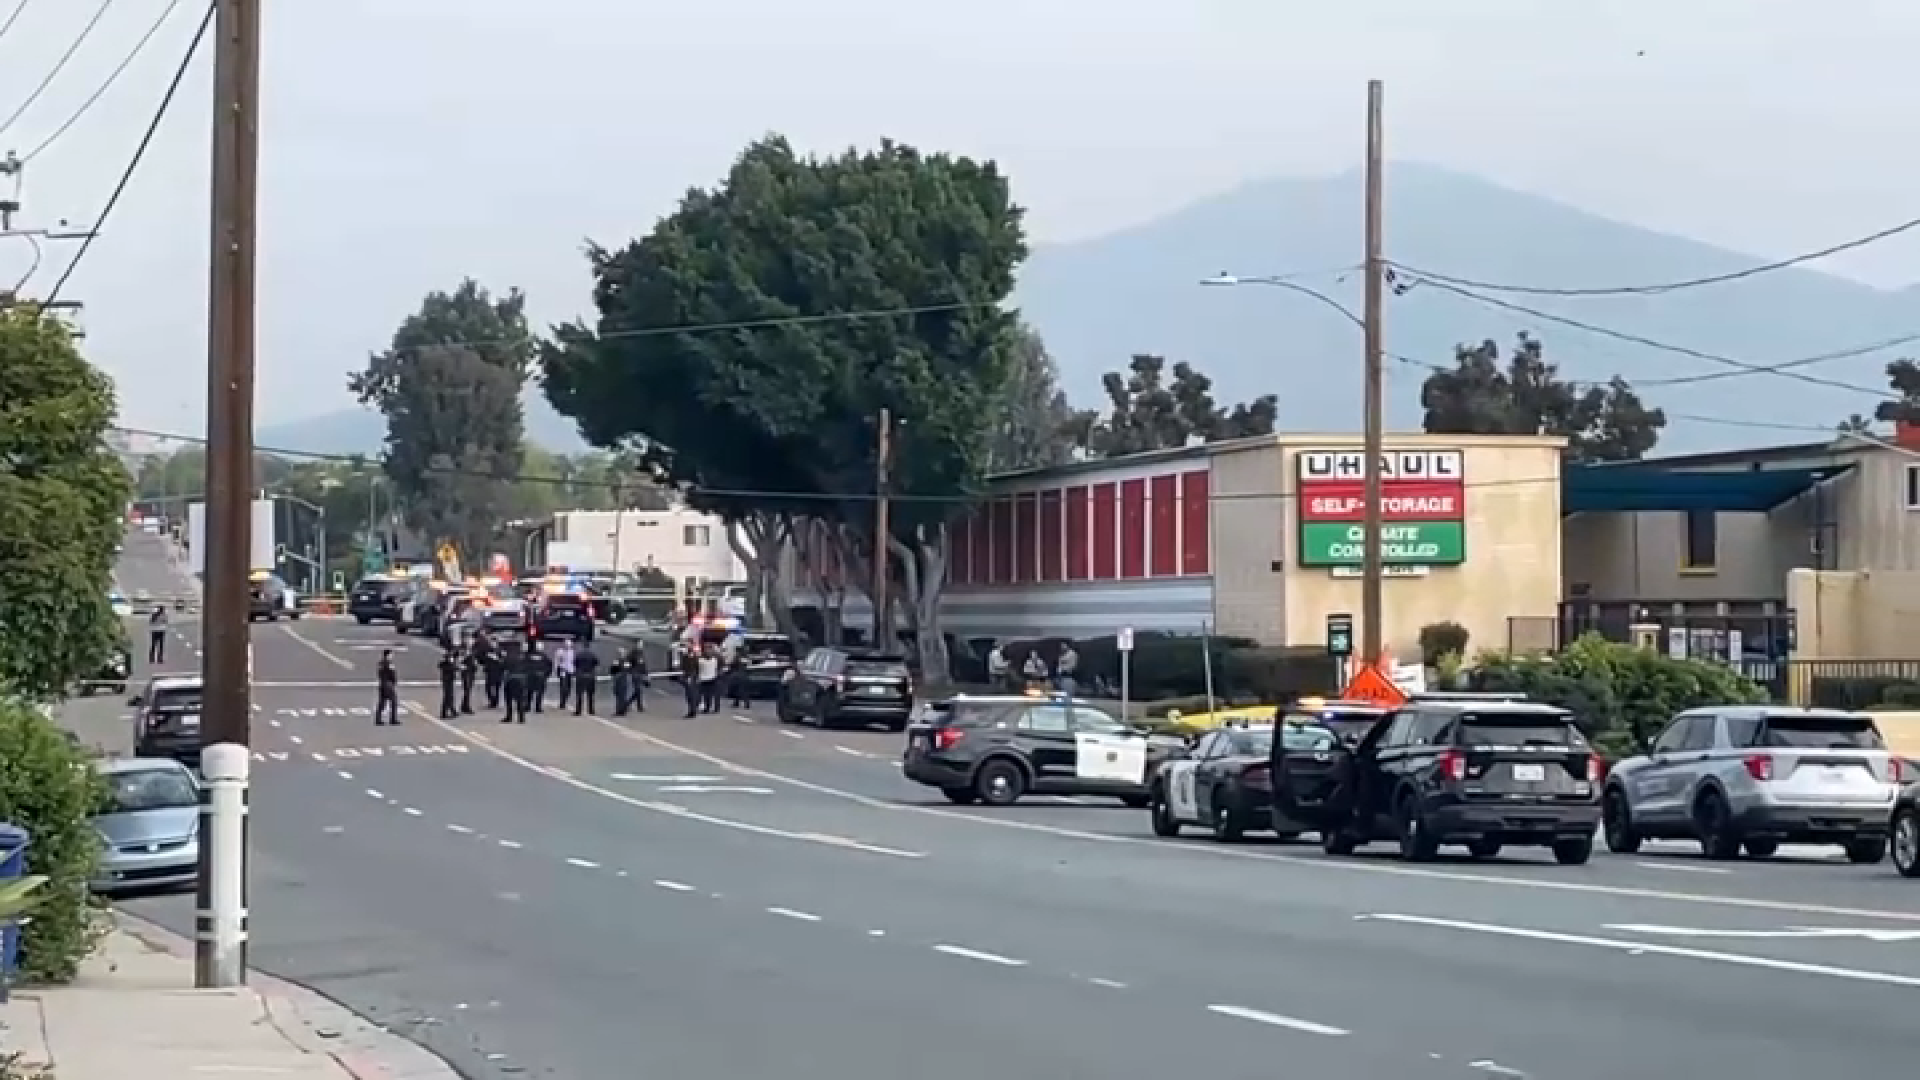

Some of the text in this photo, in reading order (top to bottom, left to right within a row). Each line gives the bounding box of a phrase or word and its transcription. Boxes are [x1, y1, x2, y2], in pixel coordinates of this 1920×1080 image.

[1311, 497, 1455, 513] SELF-TORAGE
[1346, 526, 1420, 541] CATE
[1328, 543, 1440, 558] CONOLLED
